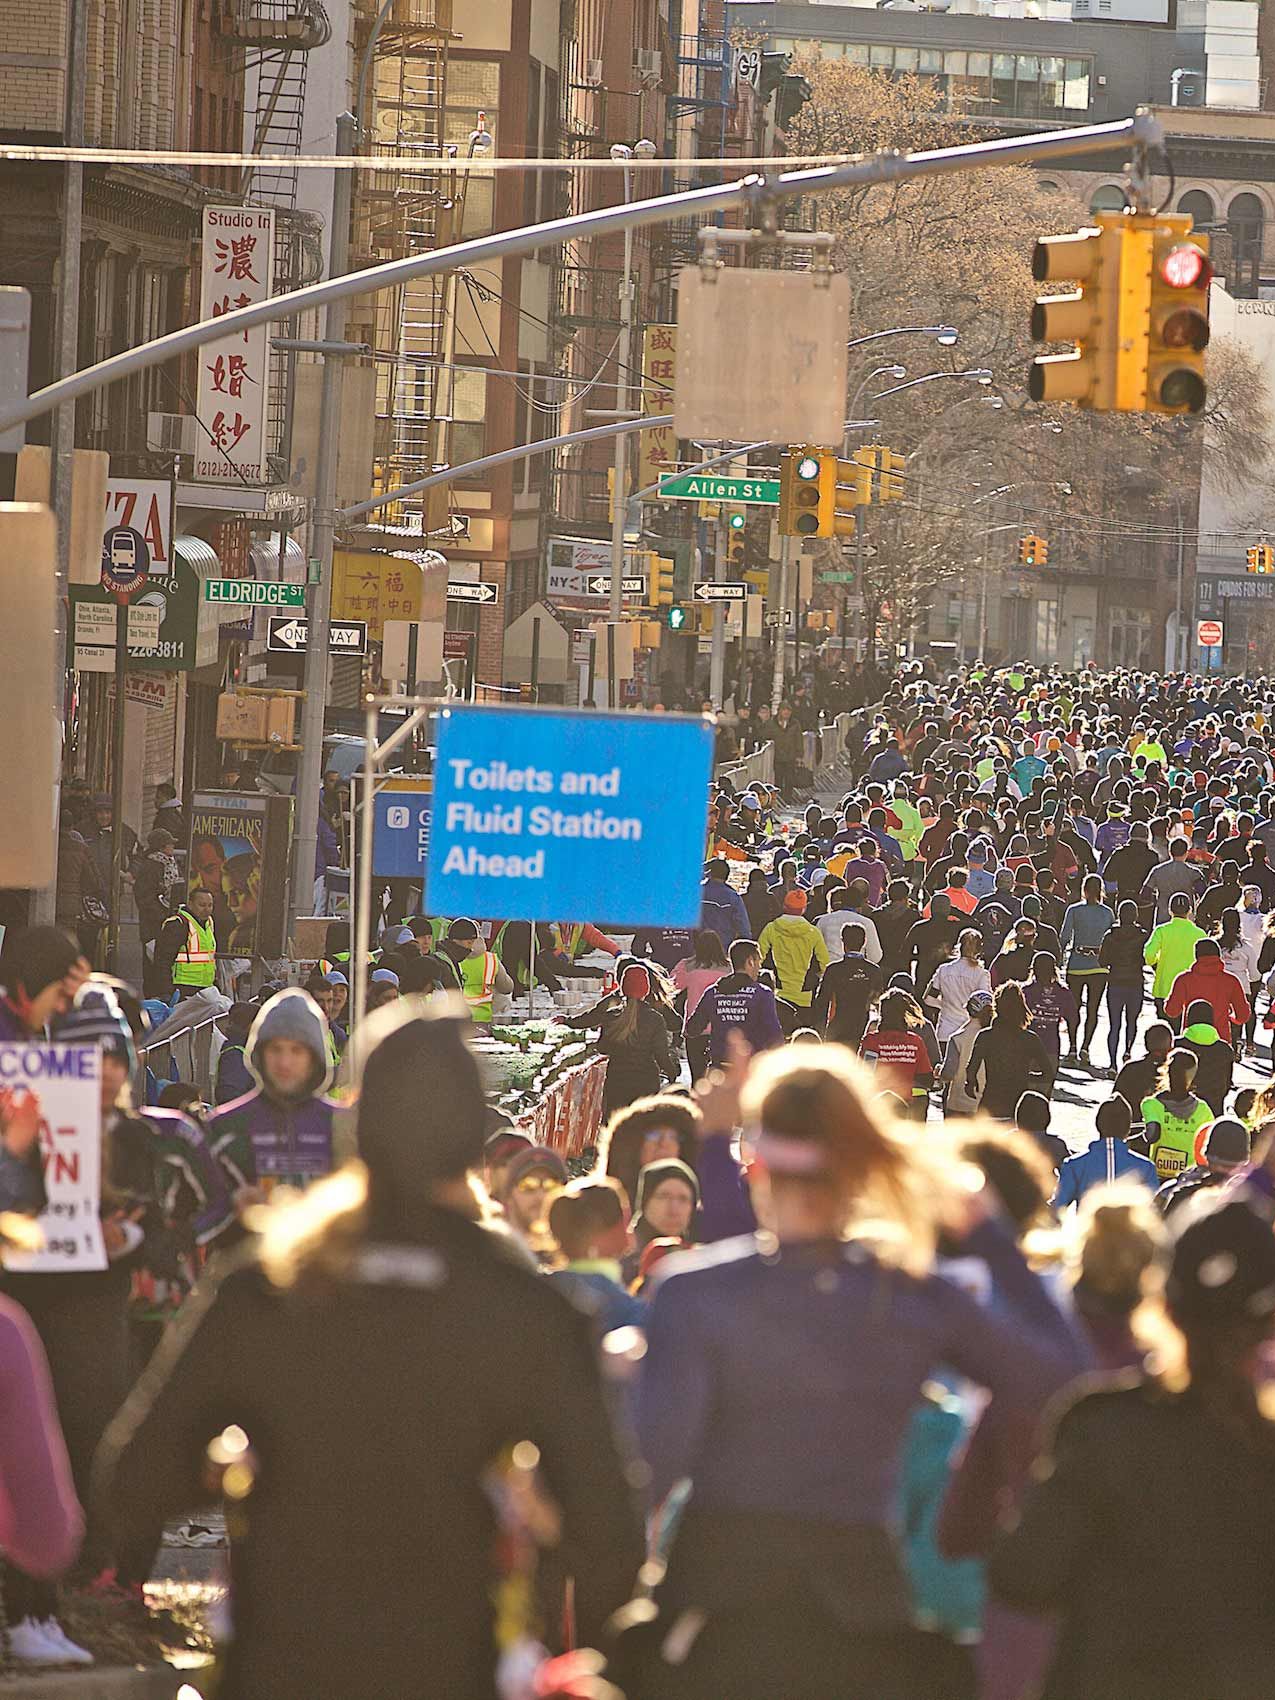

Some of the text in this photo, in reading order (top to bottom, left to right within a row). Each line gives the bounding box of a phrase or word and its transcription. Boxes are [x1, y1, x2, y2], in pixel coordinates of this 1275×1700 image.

[208, 211, 253, 228] Studio
[687, 481, 762, 498] Allen St
[112, 575, 144, 593] STANDING
[209, 581, 304, 604] ELDRIDGE ST
[471, 586, 489, 598] WAY
[596, 581, 612, 589] ONE
[723, 588, 740, 596] WAY
[1200, 582, 1213, 600] 171
[449, 759, 621, 797] Toilets and
[445, 803, 642, 841] Fluid Station
[441, 845, 546, 879] Ahead
[1156, 1159, 1185, 1171] GUIDE
